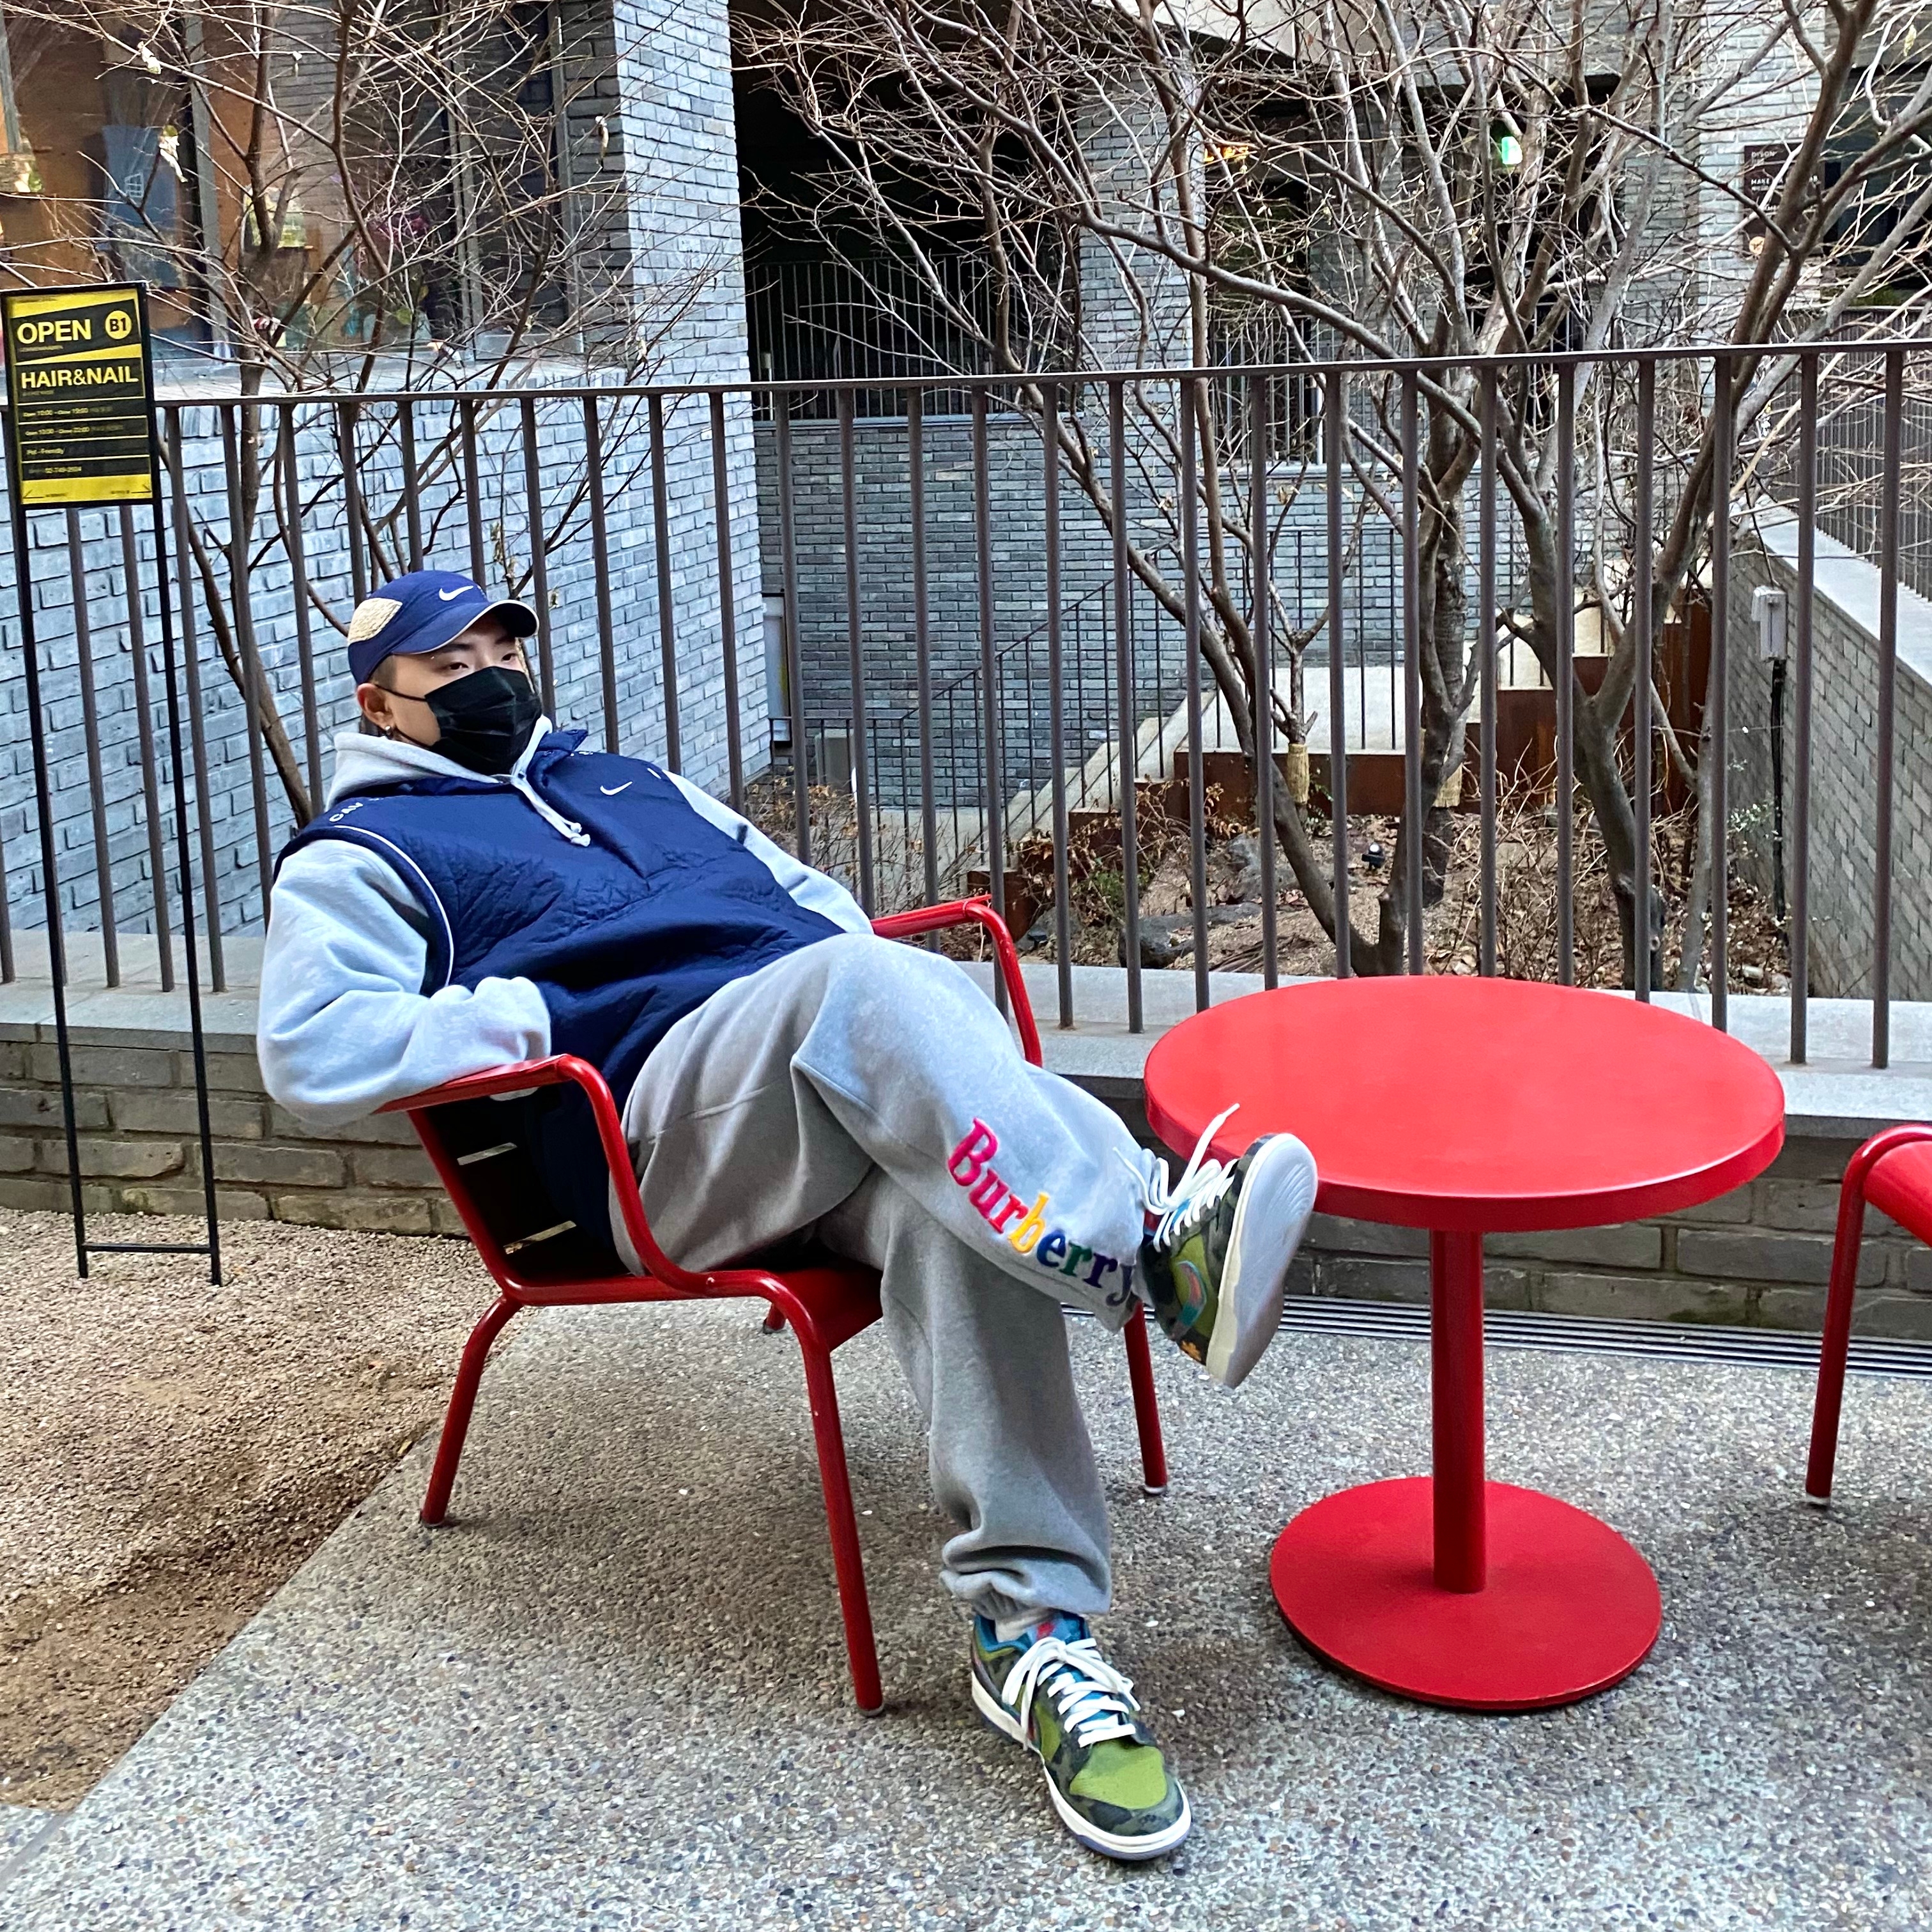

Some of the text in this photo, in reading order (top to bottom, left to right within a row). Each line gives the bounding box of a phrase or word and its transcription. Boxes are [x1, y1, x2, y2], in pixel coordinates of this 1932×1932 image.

[17, 318, 127, 344] OPEN B1
[21, 366, 139, 389] HAIR&NAIL
